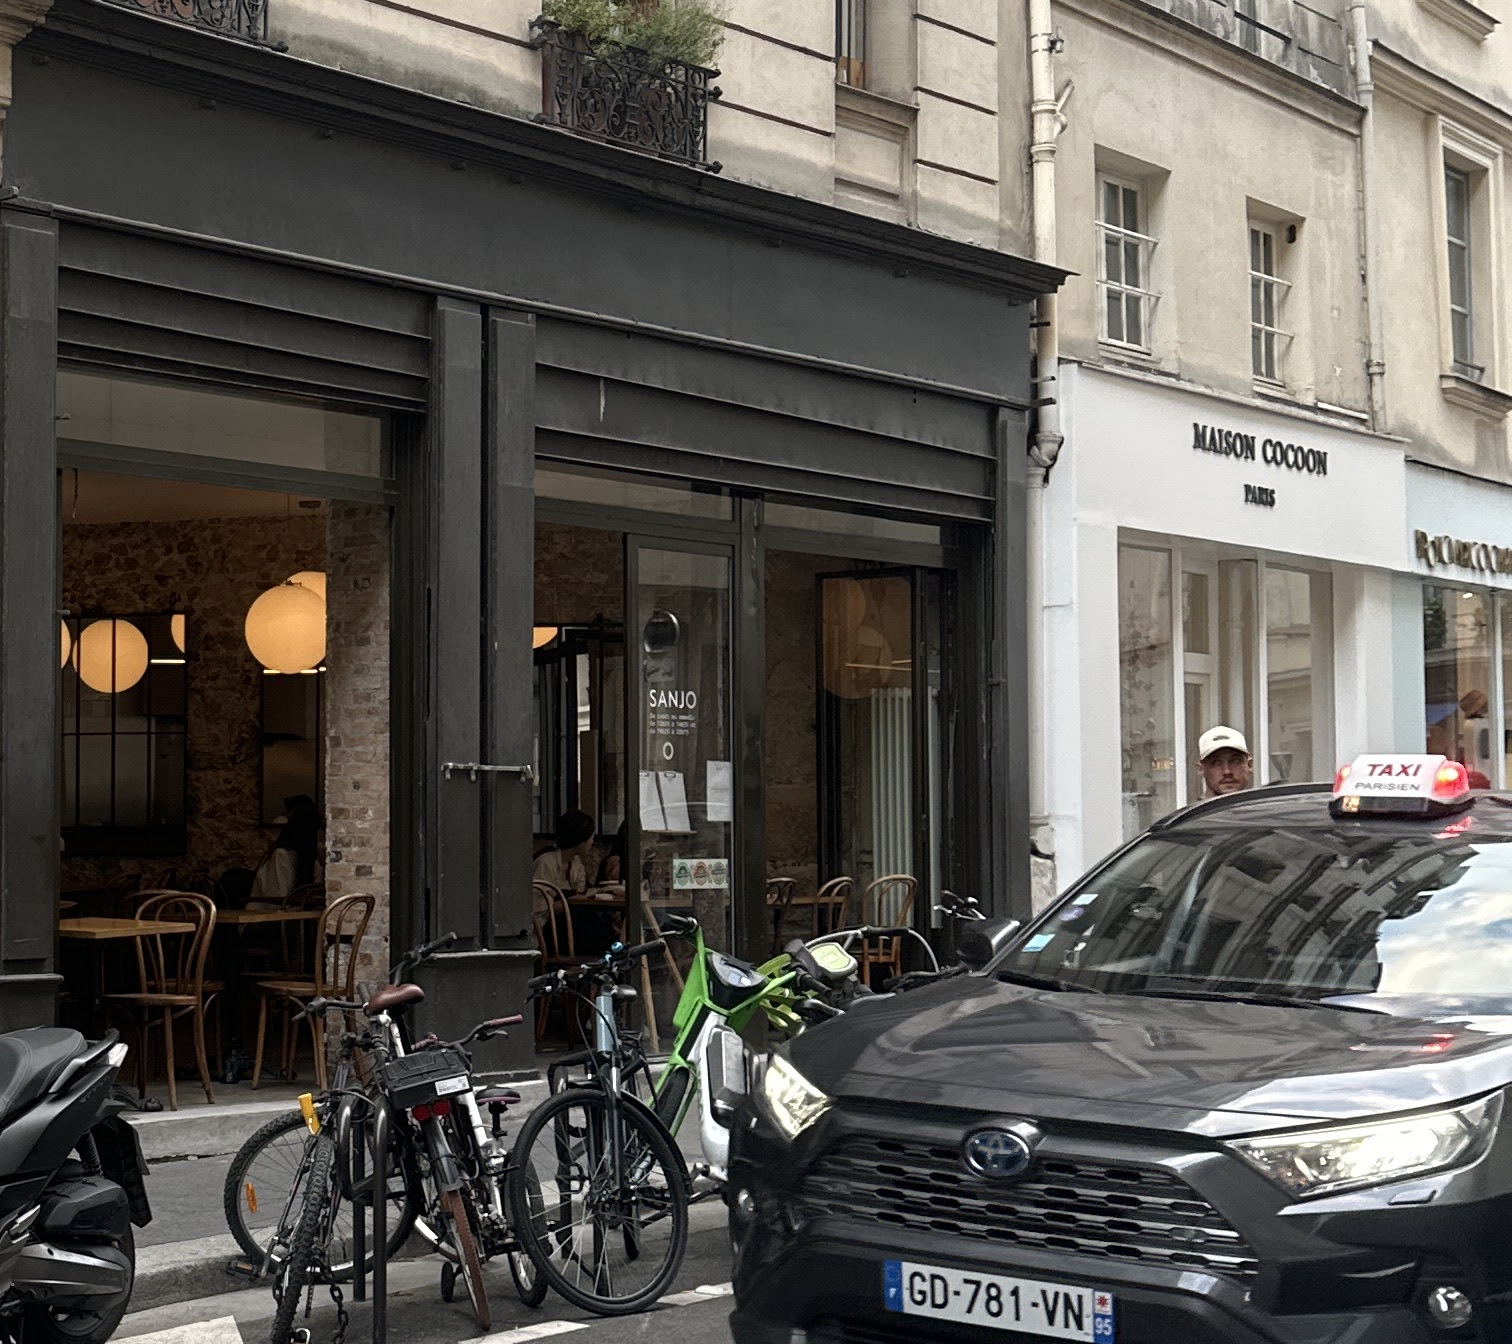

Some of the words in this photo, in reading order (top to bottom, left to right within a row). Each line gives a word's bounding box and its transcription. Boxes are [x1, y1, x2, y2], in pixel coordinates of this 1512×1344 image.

[1192, 422, 1256, 461] MAISON
[1261, 438, 1328, 476] COCOON
[1244, 483, 1276, 507] PARIS
[649, 688, 697, 709] SANJO
[1367, 763, 1423, 777] TAXI
[1354, 782, 1420, 792] PARISIEN
[908, 1271, 1085, 1332] GD-781-VN
[1094, 1317, 1113, 1337] 95
